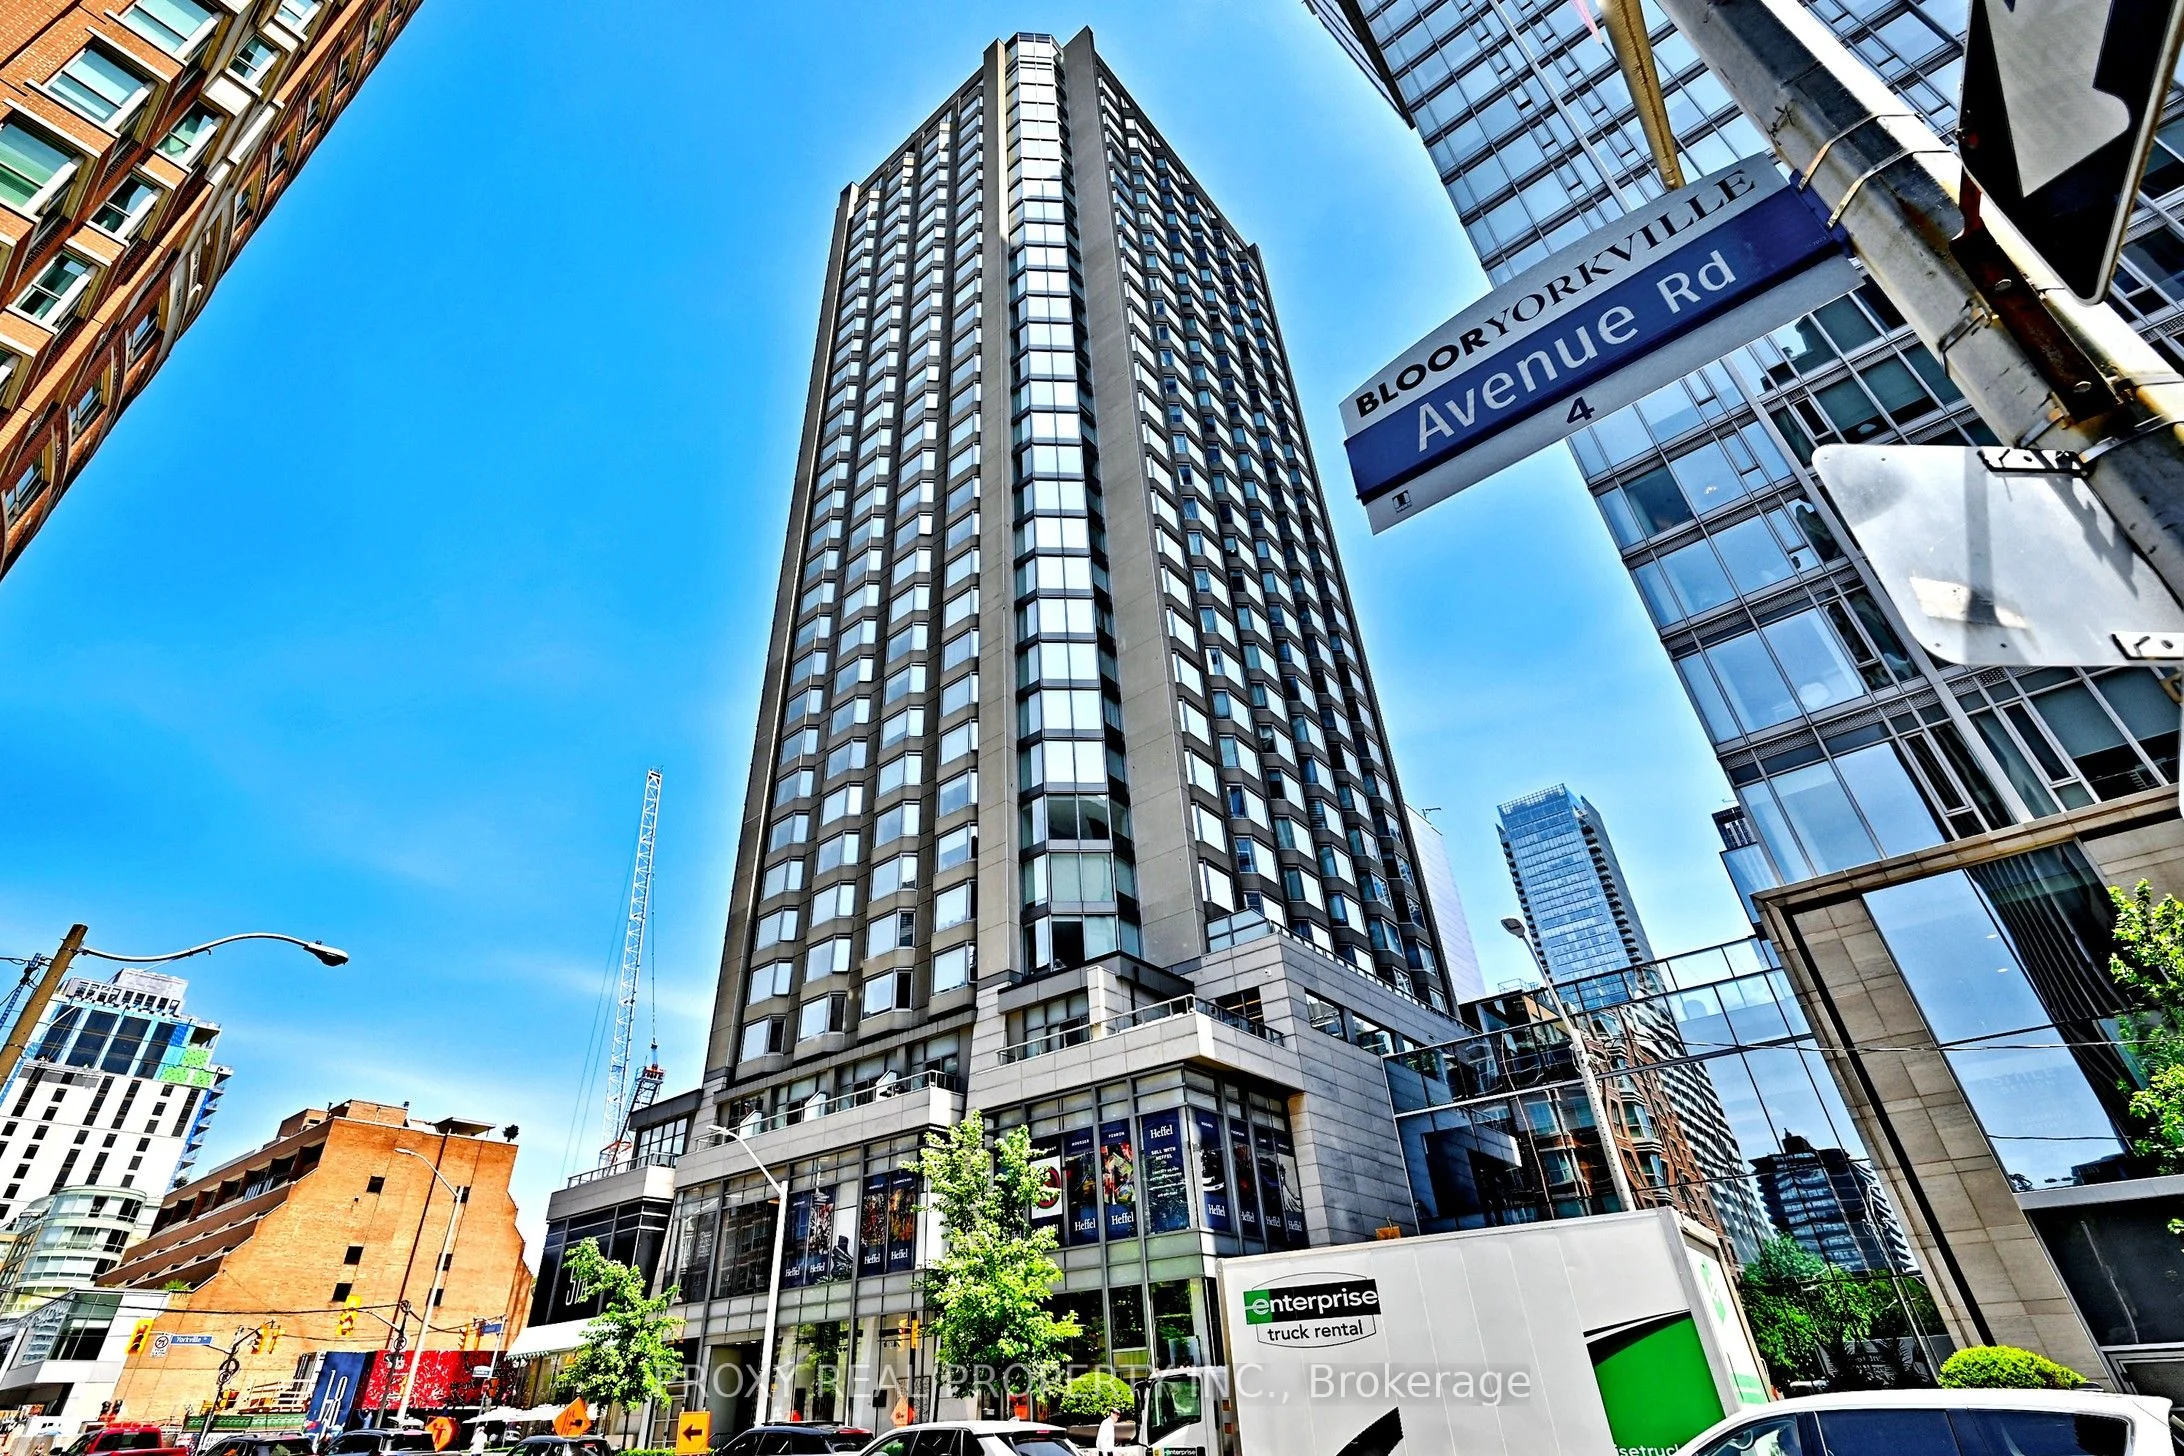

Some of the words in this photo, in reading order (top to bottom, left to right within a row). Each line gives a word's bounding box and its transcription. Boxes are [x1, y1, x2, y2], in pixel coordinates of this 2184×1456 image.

[1417, 304, 1640, 452] Avenue
[1655, 249, 1738, 314] Rd
[1566, 396, 1596, 425] 4
[1150, 1124, 1174, 1139] Heffel
[1208, 1203, 1226, 1217] Heffel
[1074, 1217, 1096, 1232] Heffel
[1111, 1211, 1135, 1226] Heffel
[863, 1252, 881, 1265] Heffel
[890, 1248, 909, 1260] Heffel
[785, 1265, 801, 1278] Heffel
[810, 1262, 826, 1274] Heffel
[1246, 1287, 1379, 1316] enterprise
[1267, 1323, 1310, 1341] truck
[1314, 1318, 1363, 1338] rental
